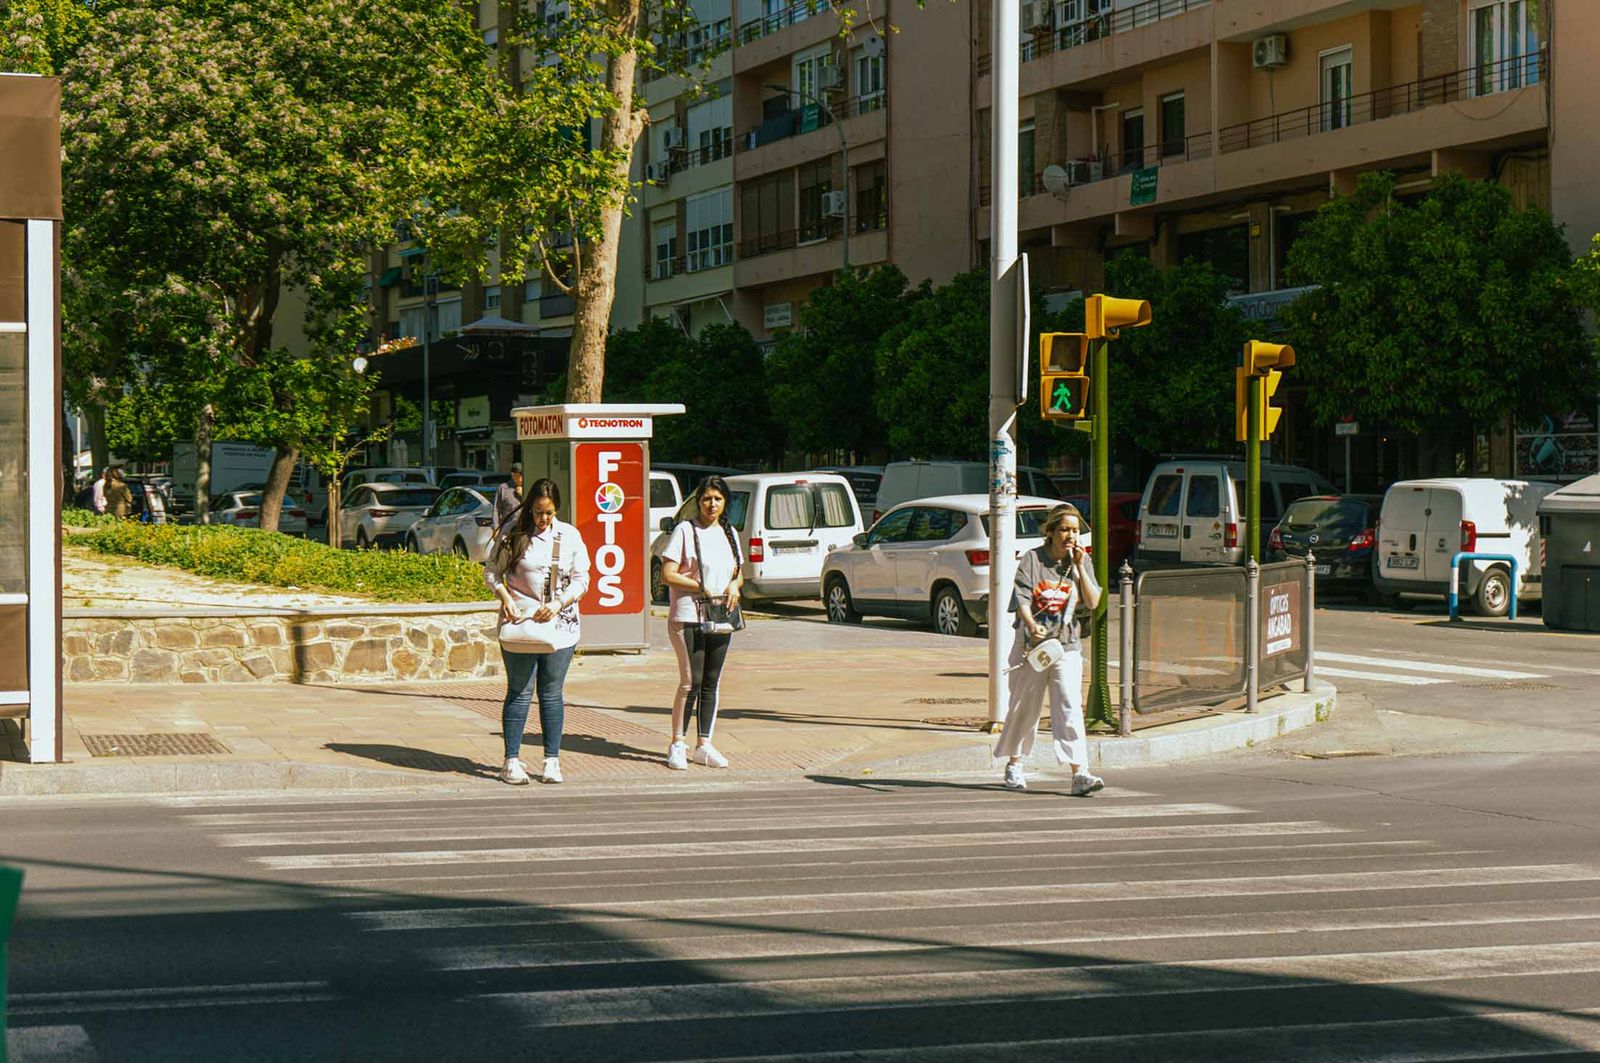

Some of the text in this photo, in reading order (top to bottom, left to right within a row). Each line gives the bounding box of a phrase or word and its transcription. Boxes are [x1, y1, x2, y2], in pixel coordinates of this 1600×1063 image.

[520, 414, 563, 436] FOTOMATON
[588, 419, 643, 428] TECNOTRON
[594, 451, 625, 607] FOTOS
